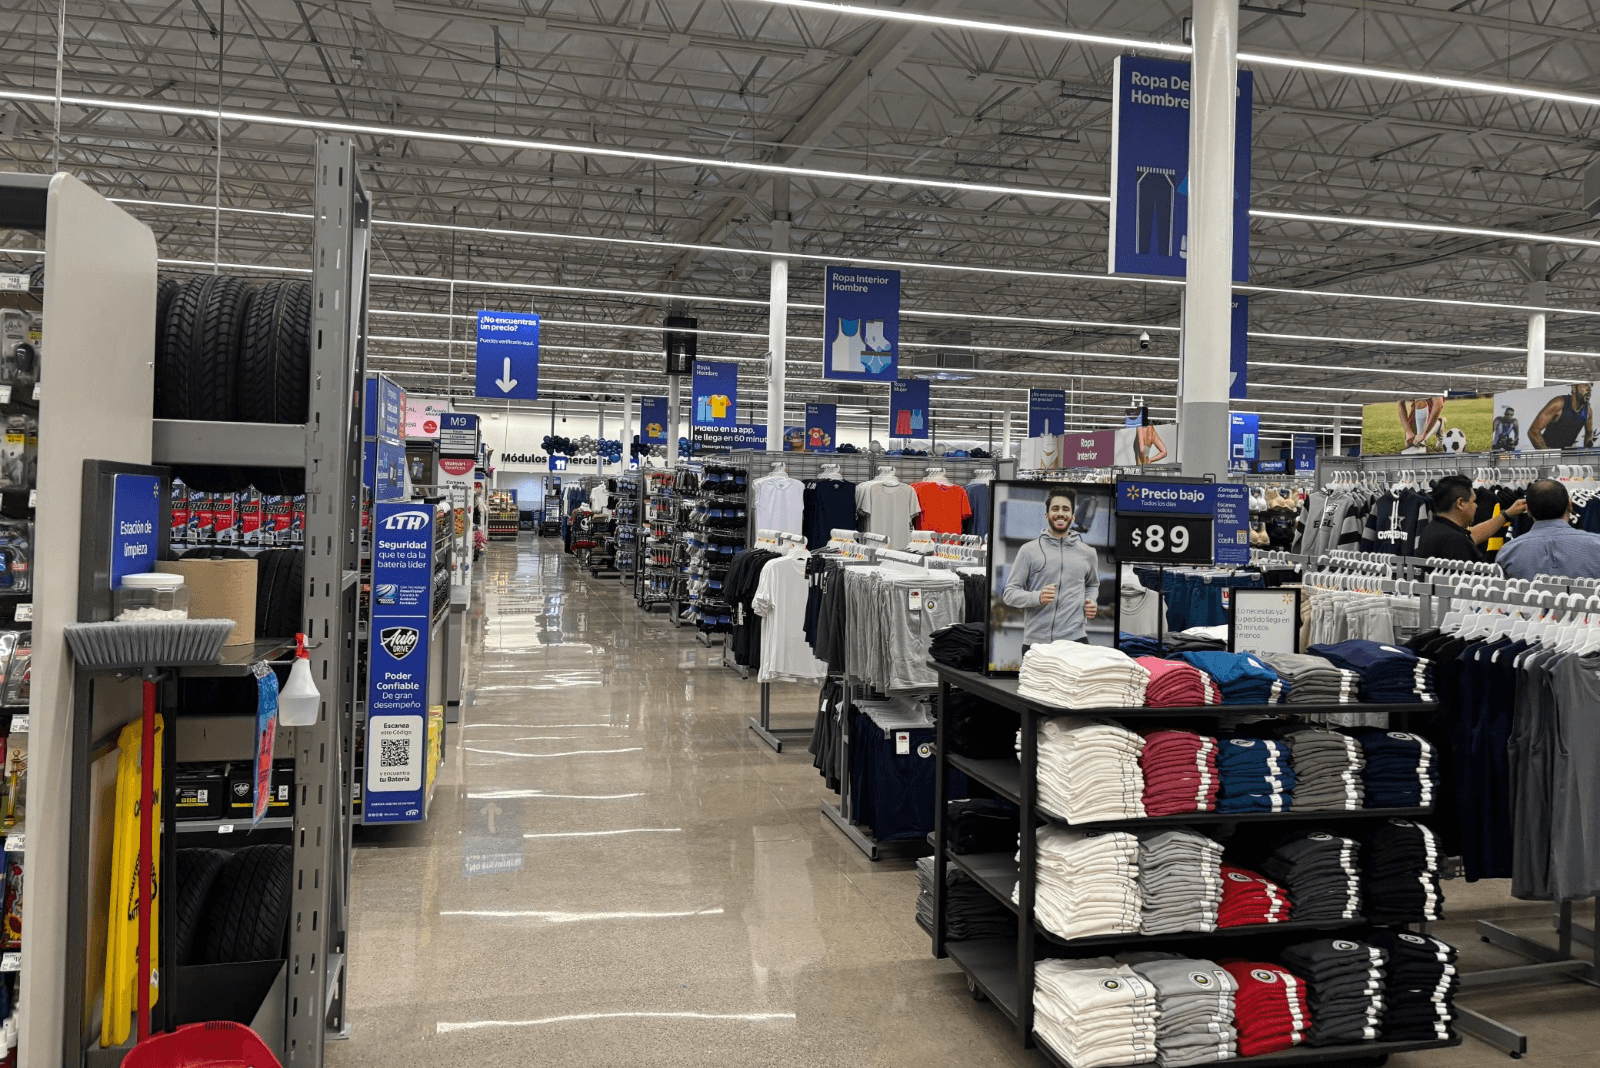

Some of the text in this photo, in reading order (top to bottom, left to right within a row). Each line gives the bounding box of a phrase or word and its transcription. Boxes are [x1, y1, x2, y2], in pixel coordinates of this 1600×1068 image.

[1131, 71, 1168, 89] Ropa
[1131, 89, 1190, 109] Hombre
[832, 272, 889, 285] Ropa Interior
[832, 282, 868, 293] Hombre
[480, 316, 537, 326] ¿No encuentras
[450, 416, 467, 427] M9
[720, 426, 732, 434] en
[732, 426, 741, 434] la
[741, 428, 756, 436] app,
[703, 434, 722, 443] llega
[1080, 438, 1095, 448] Ropa
[501, 452, 547, 464] Módulos
[1077, 450, 1098, 461] Interior
[554, 459, 567, 471] 11
[1141, 487, 1205, 502] Precio bajo
[120, 519, 152, 535] Estación de
[385, 516, 422, 530] LTH
[1131, 524, 1190, 554] $89
[378, 540, 427, 550] Seguridad
[123, 543, 148, 559] limpieza
[378, 551, 426, 560] que te da la
[377, 560, 427, 569] batería líder
[1243, 615, 1265, 623] pedido
[1265, 616, 1280, 624] llega
[380, 629, 417, 647] Auto
[392, 645, 410, 653] DRIVE
[385, 672, 412, 680] Poder
[376, 682, 420, 690] Confiable
[394, 692, 413, 701] gran
[373, 701, 421, 710] desempeño
